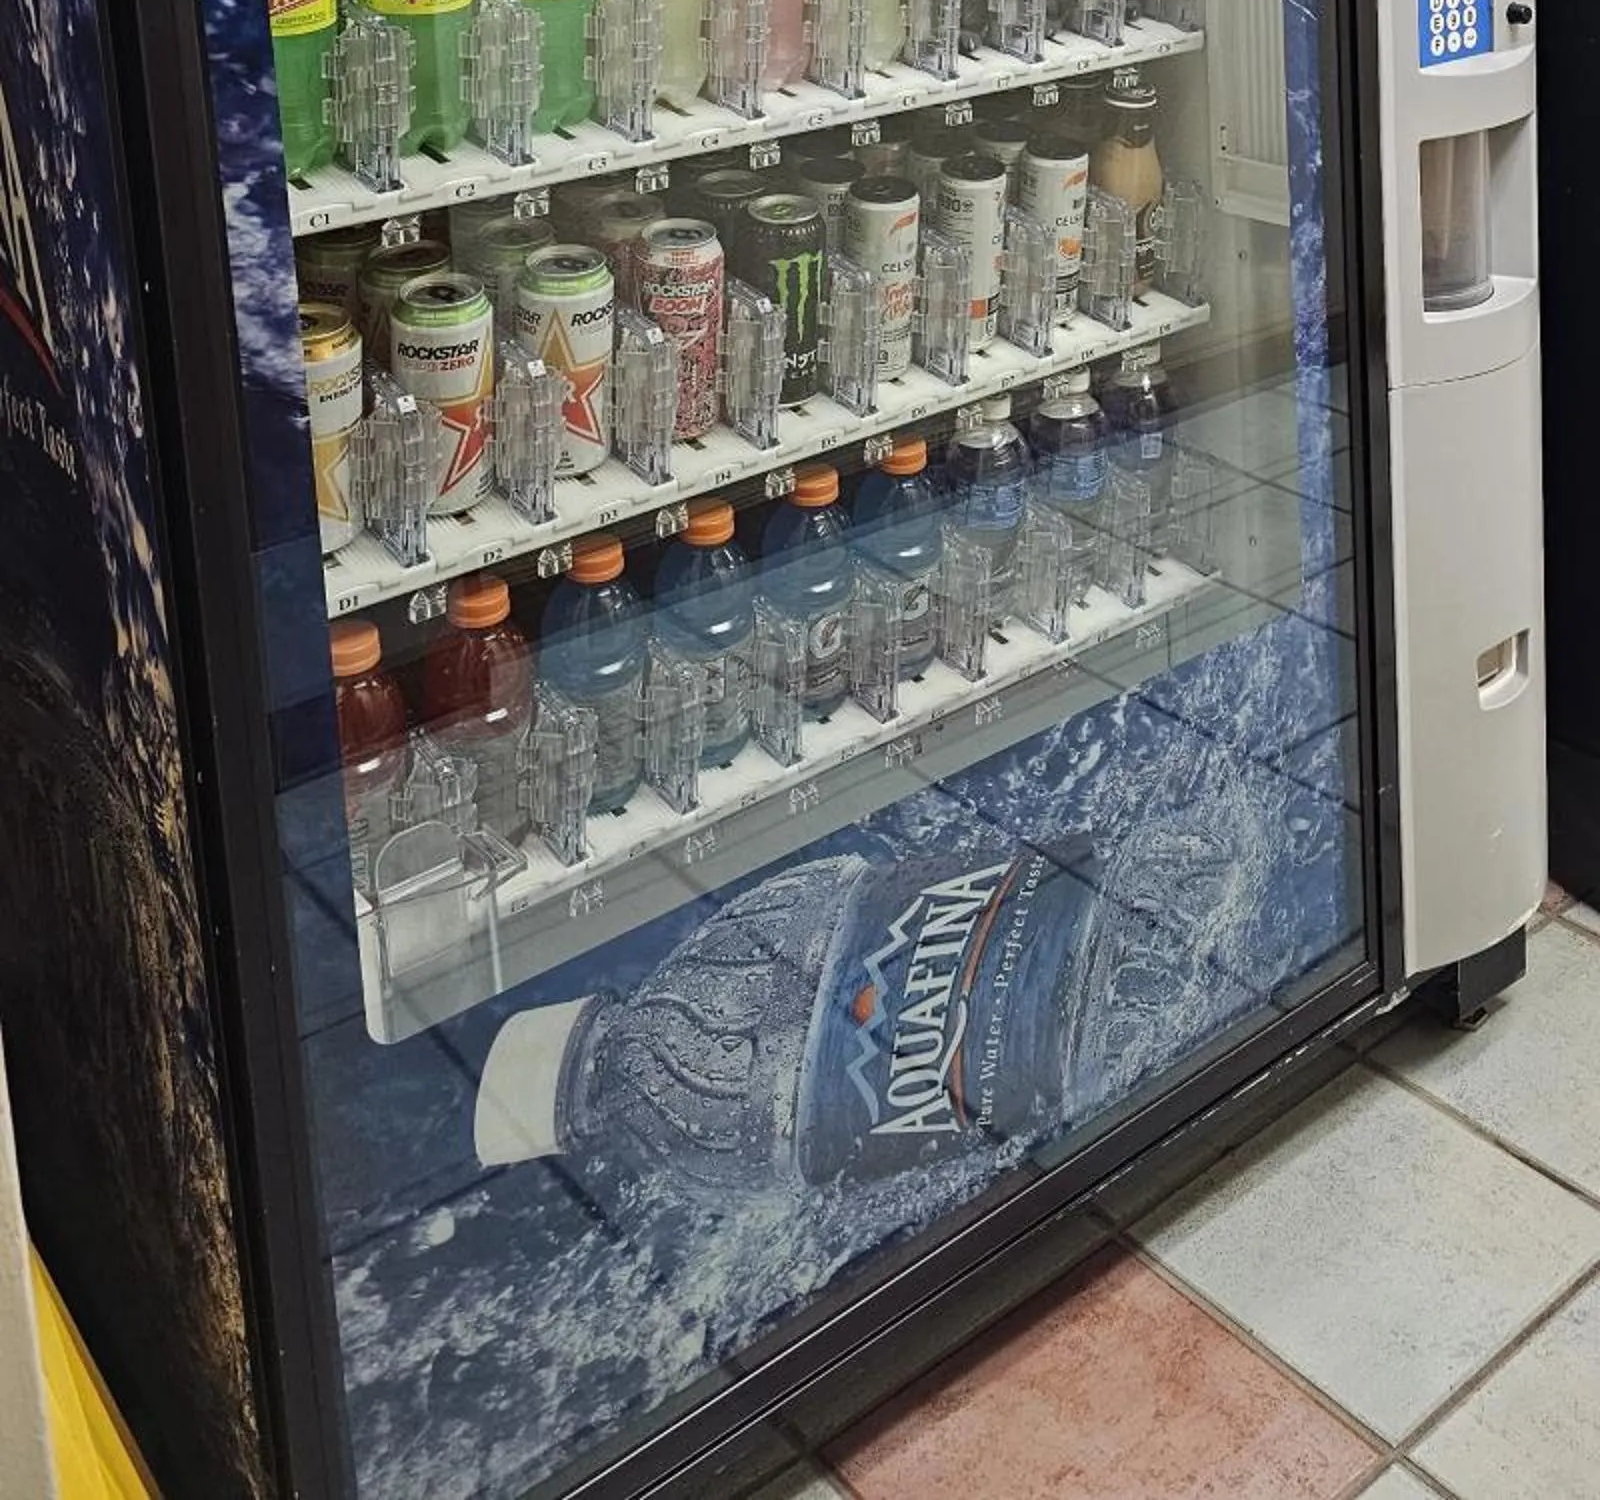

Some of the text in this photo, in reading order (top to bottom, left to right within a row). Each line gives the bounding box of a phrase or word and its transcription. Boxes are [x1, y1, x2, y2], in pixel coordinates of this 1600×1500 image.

[455, 182, 477, 198] C2
[309, 213, 331, 229] C1
[397, 339, 479, 360] ROCKSTAR
[440, 355, 475, 371] ZERO
[600, 509, 618, 525] D3
[483, 548, 503, 564] D2
[338, 595, 359, 611] D1
[869, 861, 1013, 1135] AQUAFINA
[976, 854, 1047, 1130] Pure Water Perfect Taste
